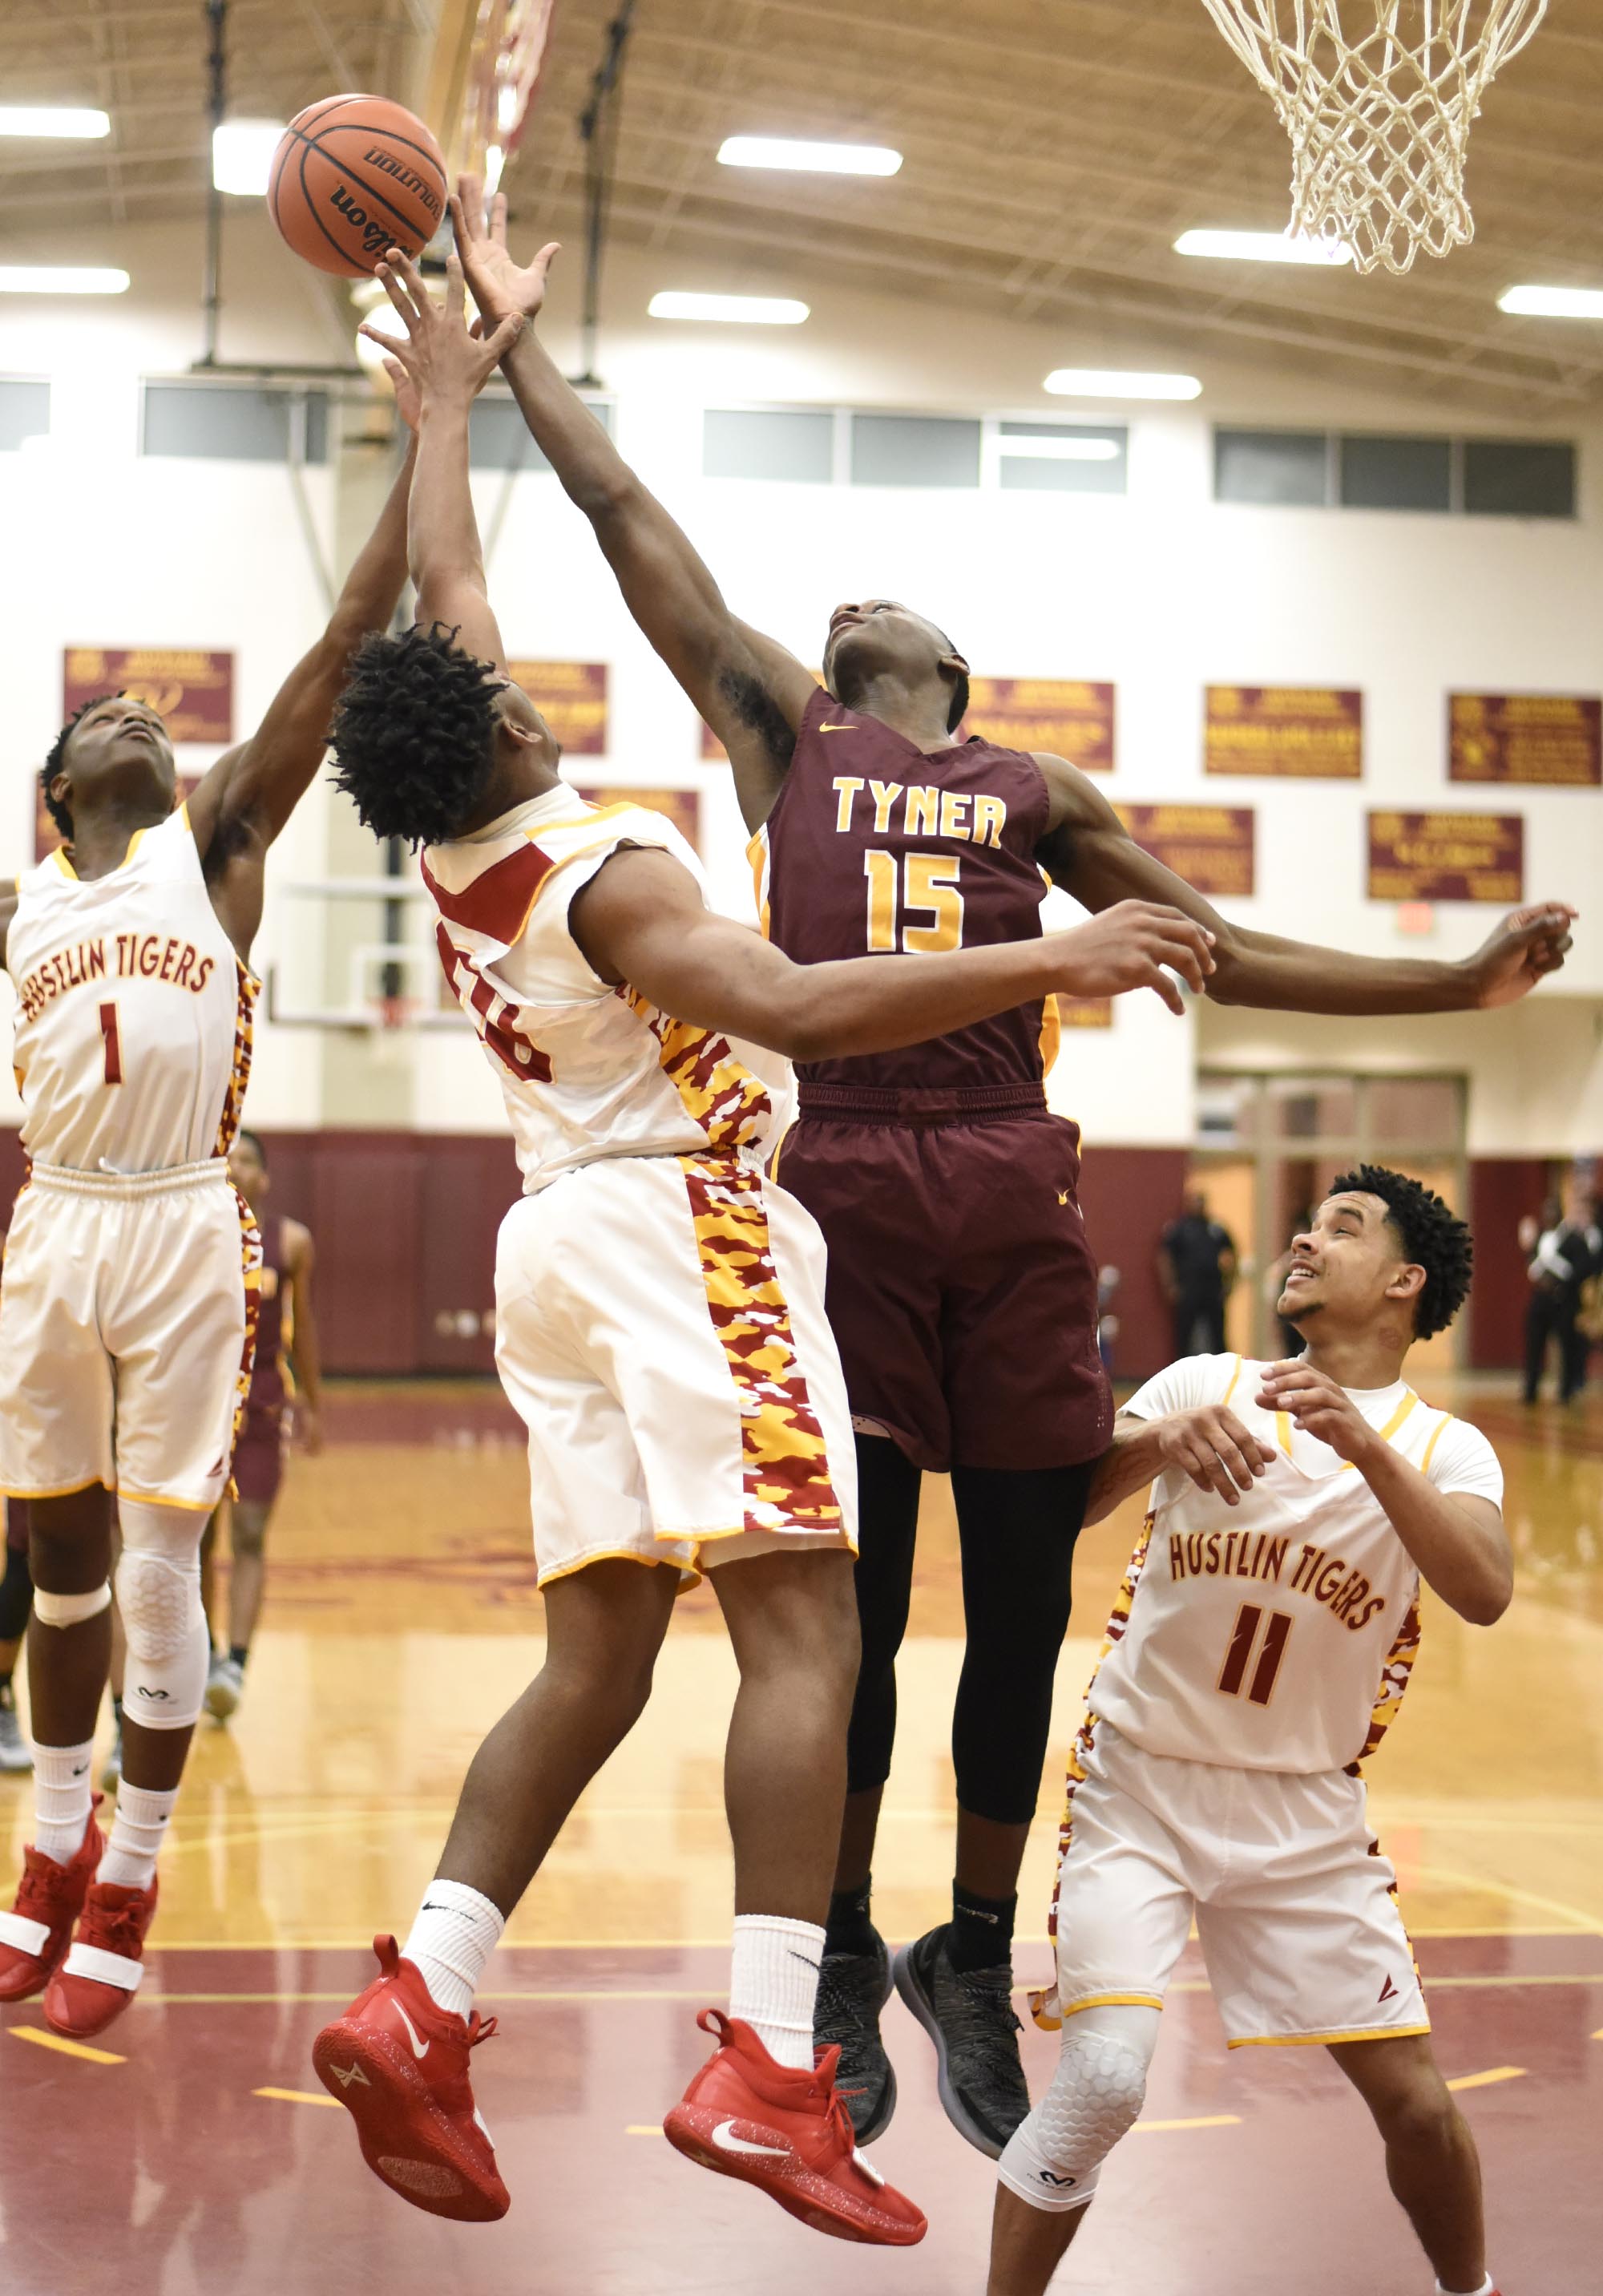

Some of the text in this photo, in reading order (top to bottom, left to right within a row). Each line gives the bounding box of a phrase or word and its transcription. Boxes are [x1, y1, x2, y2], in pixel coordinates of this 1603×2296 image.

[833, 777, 1006, 849] TYNER
[864, 849, 964, 954] 15
[116, 935, 215, 993] TIGERS
[98, 1001, 123, 1085] 1
[1169, 1530, 1386, 1631] HUSTLIN TIGERS
[1216, 1602, 1295, 1708] 11
